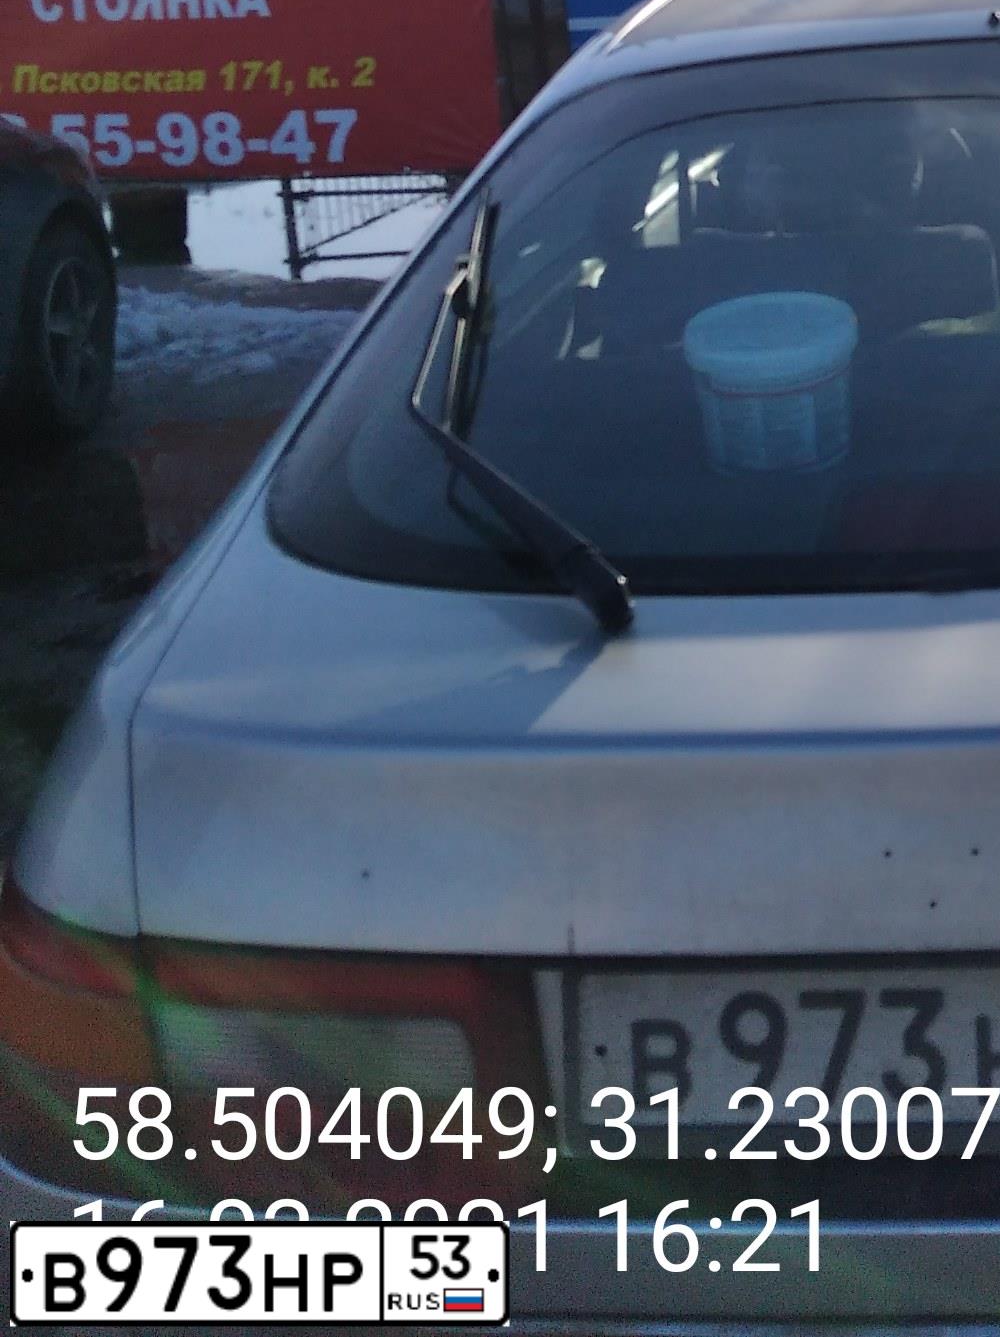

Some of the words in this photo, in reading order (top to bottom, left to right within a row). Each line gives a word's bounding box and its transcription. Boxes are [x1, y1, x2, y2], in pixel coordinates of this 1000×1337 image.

[12, 61, 206, 95] Псковская
[219, 60, 293, 95] 171,
[307, 70, 338, 90] к.
[352, 57, 376, 87] 2
